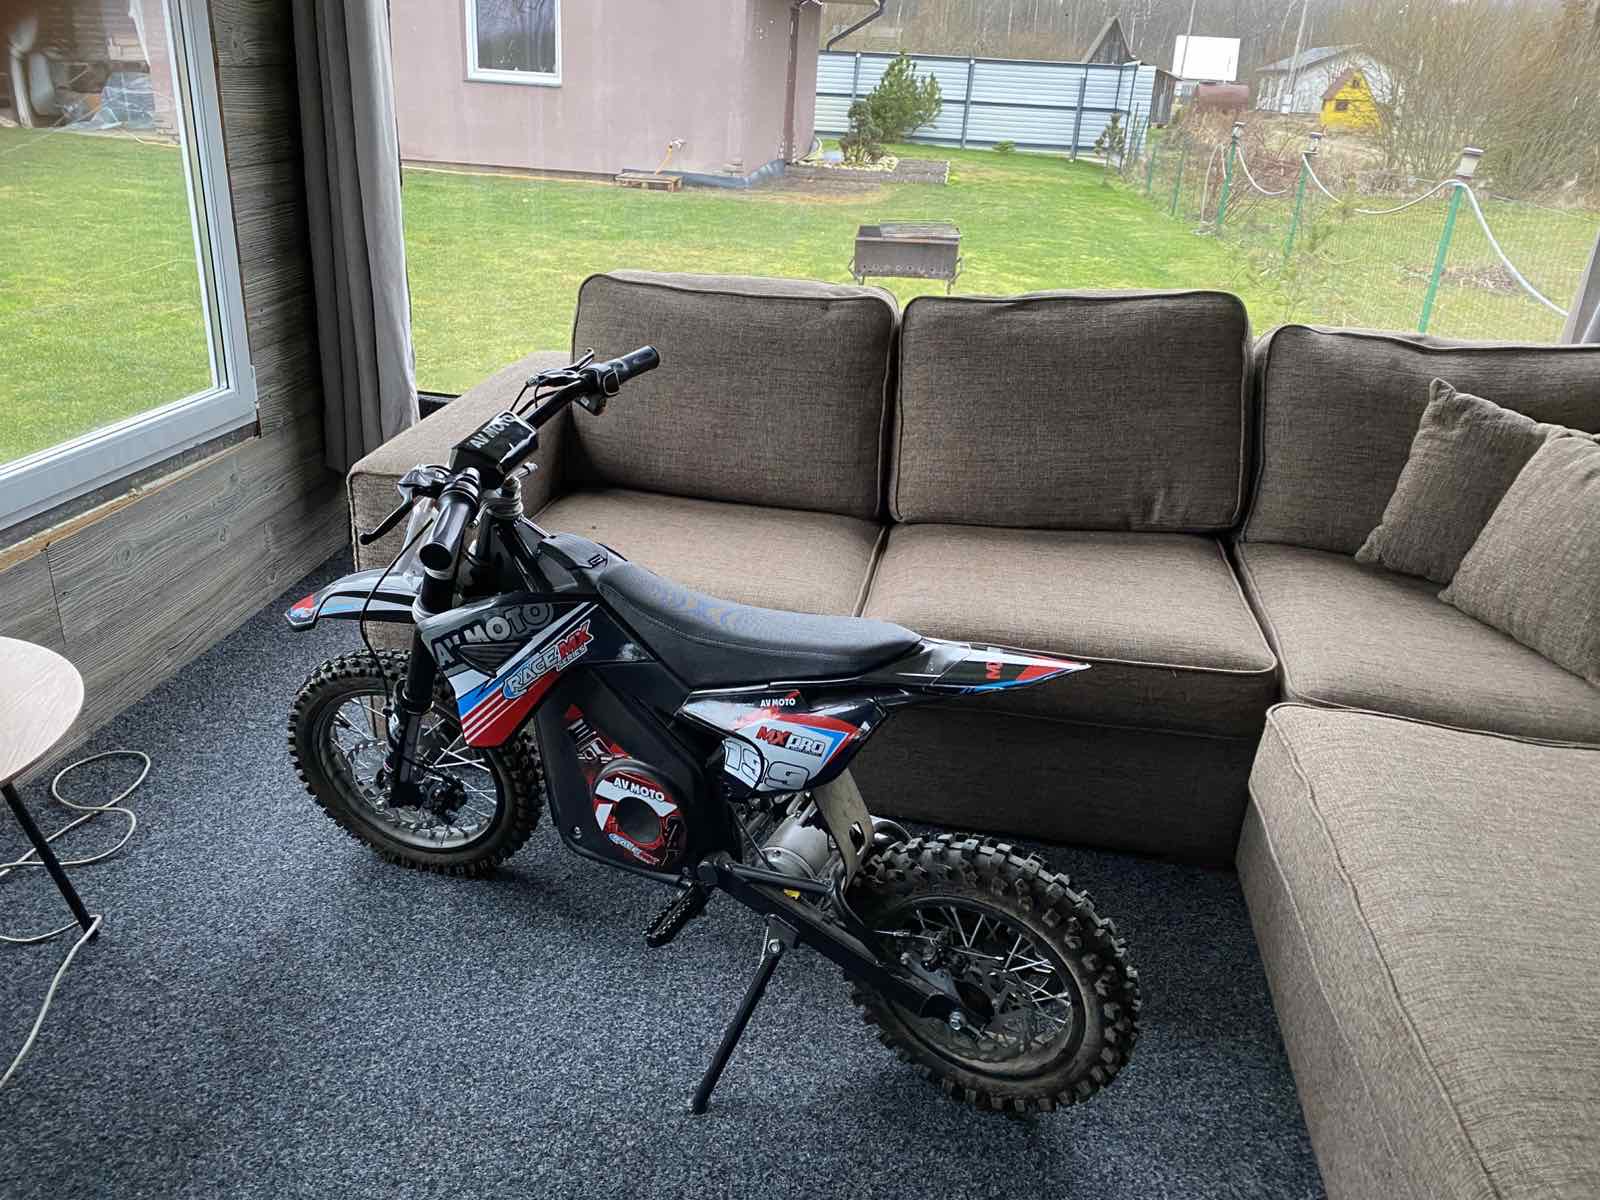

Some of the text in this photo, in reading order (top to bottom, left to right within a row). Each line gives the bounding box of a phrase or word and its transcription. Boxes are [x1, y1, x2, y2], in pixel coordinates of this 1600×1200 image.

[469, 415, 514, 448] AV MOTO
[463, 603, 550, 643] MOTO
[760, 698, 796, 707] AV MOTO
[613, 777, 665, 801] AV MOTO
